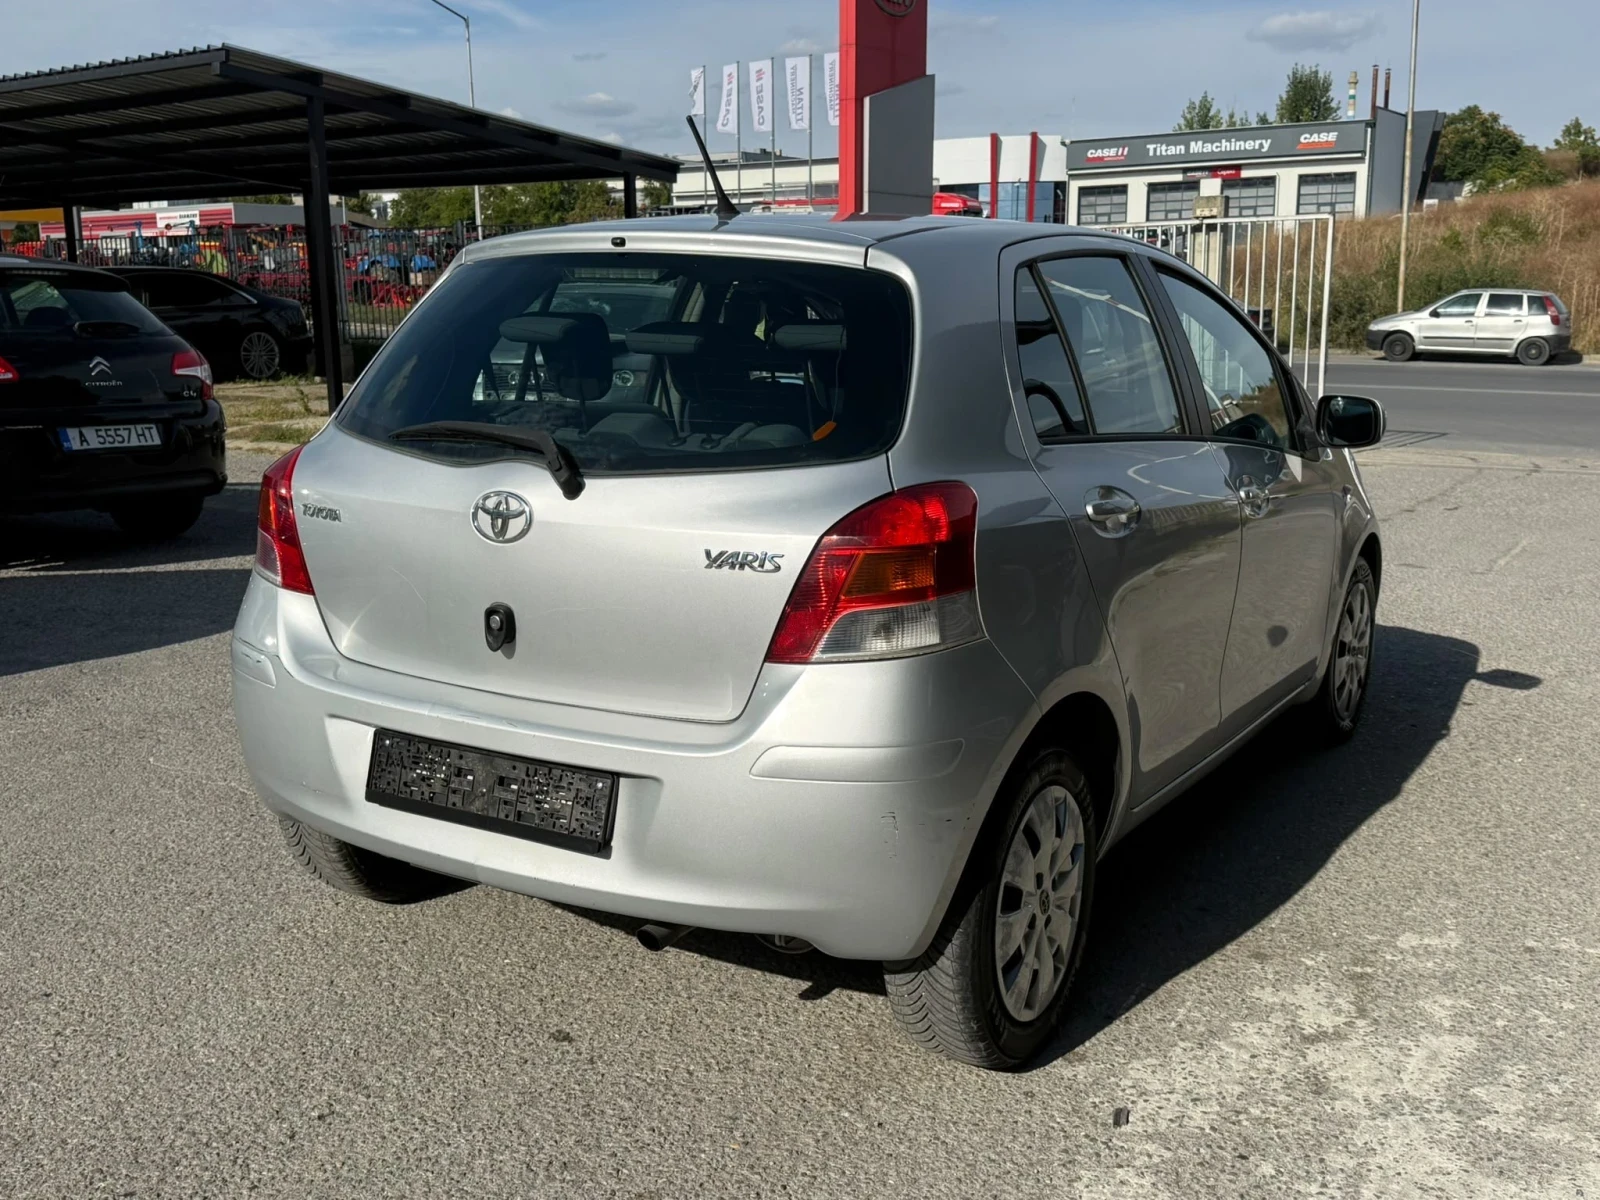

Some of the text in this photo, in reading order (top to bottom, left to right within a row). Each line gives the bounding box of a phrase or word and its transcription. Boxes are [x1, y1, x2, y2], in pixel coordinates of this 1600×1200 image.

[1300, 132, 1338, 143] CASE
[1087, 147, 1117, 157] CASE
[1146, 138, 1271, 156] Titan Machinery
[78, 426, 155, 447] A 5557 HT
[302, 503, 342, 522] TOYOTA
[704, 548, 785, 573] YARIS
